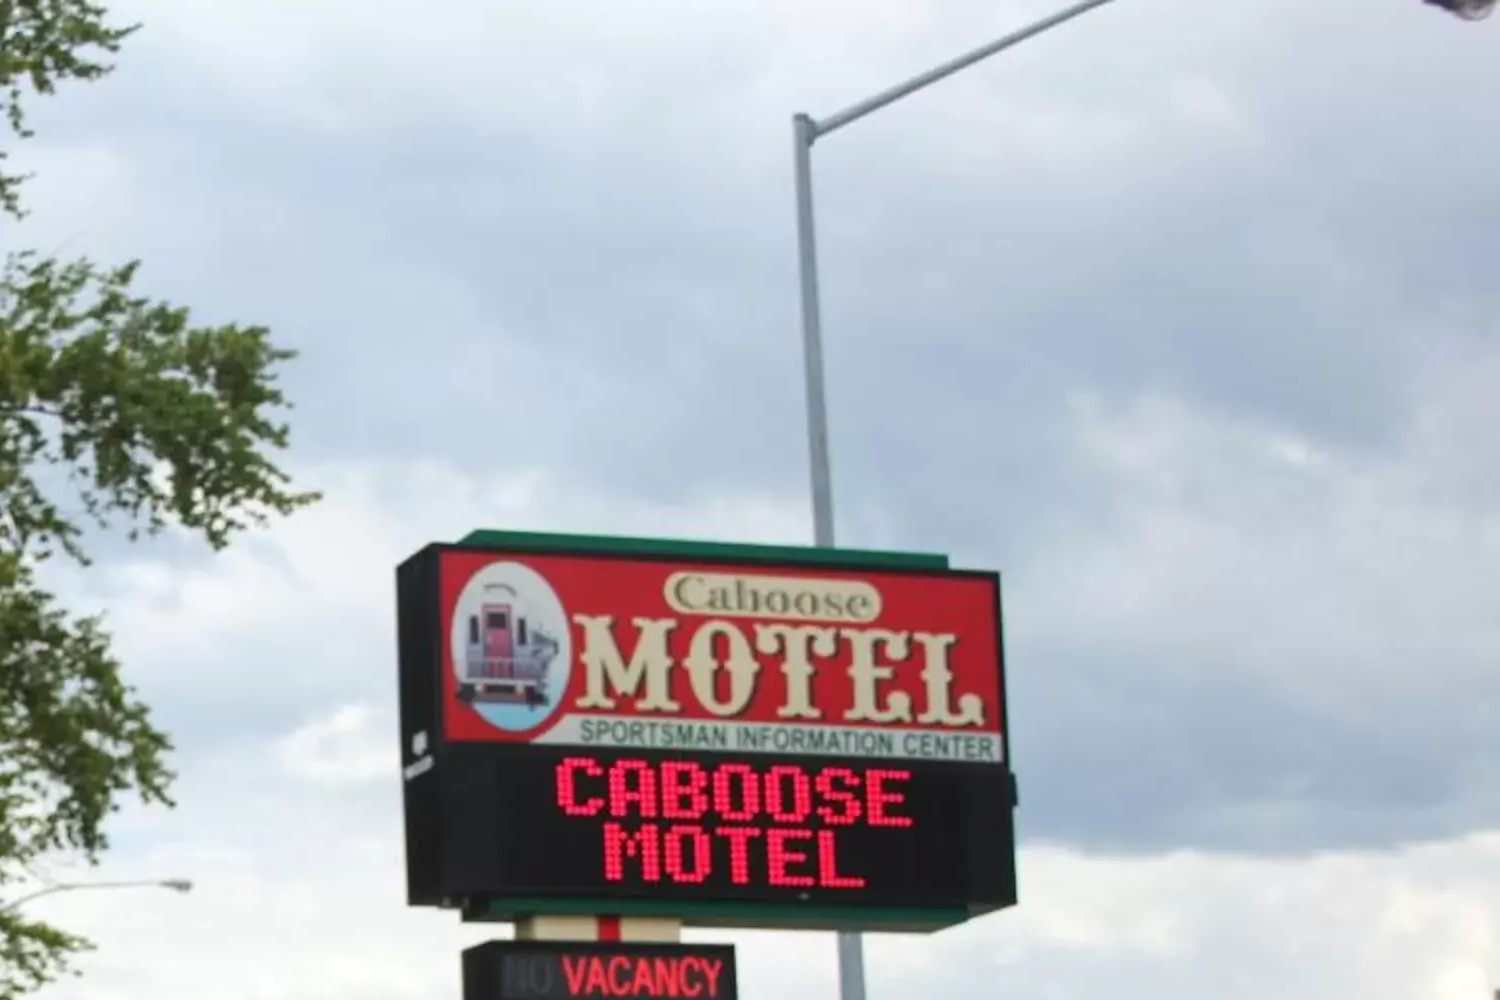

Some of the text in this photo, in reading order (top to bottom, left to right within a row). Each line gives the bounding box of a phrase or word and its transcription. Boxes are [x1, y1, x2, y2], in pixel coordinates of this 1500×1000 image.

[673, 574, 873, 619] Caboose
[573, 614, 985, 727] MOTEL
[580, 719, 995, 761] SPORTSMAN INFORMATION CENTER
[555, 757, 913, 827] CABOOSE
[603, 822, 867, 888] MOTEL
[561, 955, 723, 998] VACANCY
